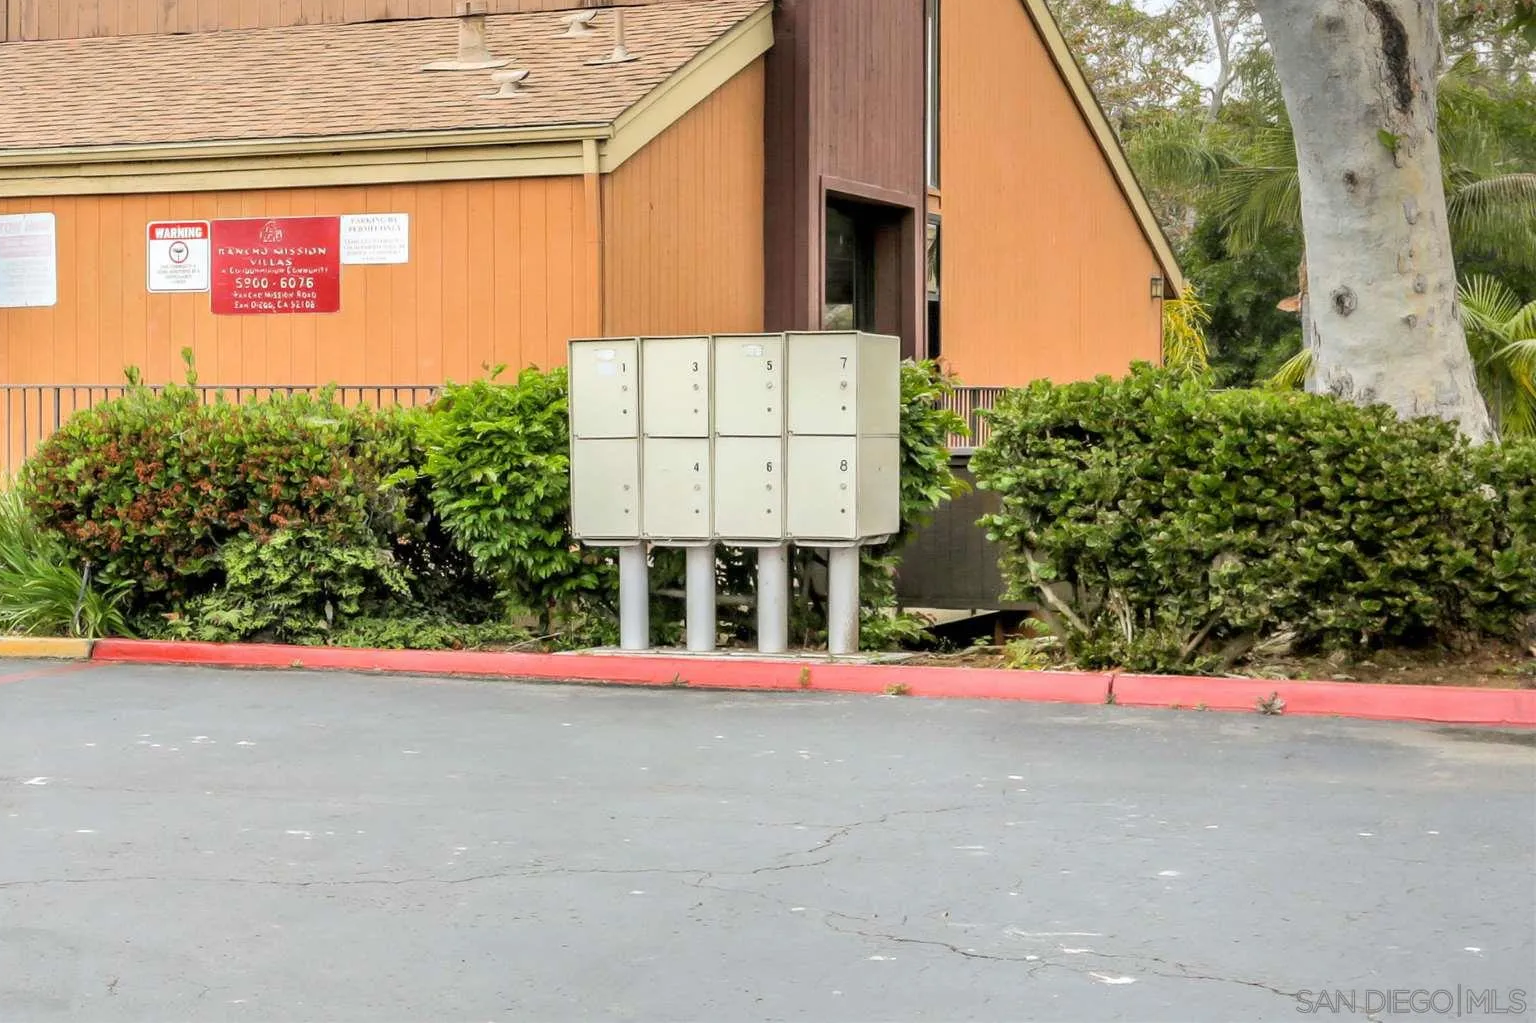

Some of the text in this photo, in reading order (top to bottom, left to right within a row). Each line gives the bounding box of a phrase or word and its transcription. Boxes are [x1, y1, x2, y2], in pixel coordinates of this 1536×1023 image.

[155, 227, 203, 239] WARNING
[218, 247, 327, 256] RANCHO MISSION
[249, 258, 293, 266] VILLAS
[235, 277, 268, 289] 5900
[280, 277, 314, 288] 6076
[621, 362, 626, 373] 1
[692, 361, 699, 373] 3
[766, 360, 773, 372] 5
[840, 357, 848, 370] 7
[693, 462, 700, 473] 4
[766, 462, 773, 473] 6
[839, 460, 848, 472] 8
